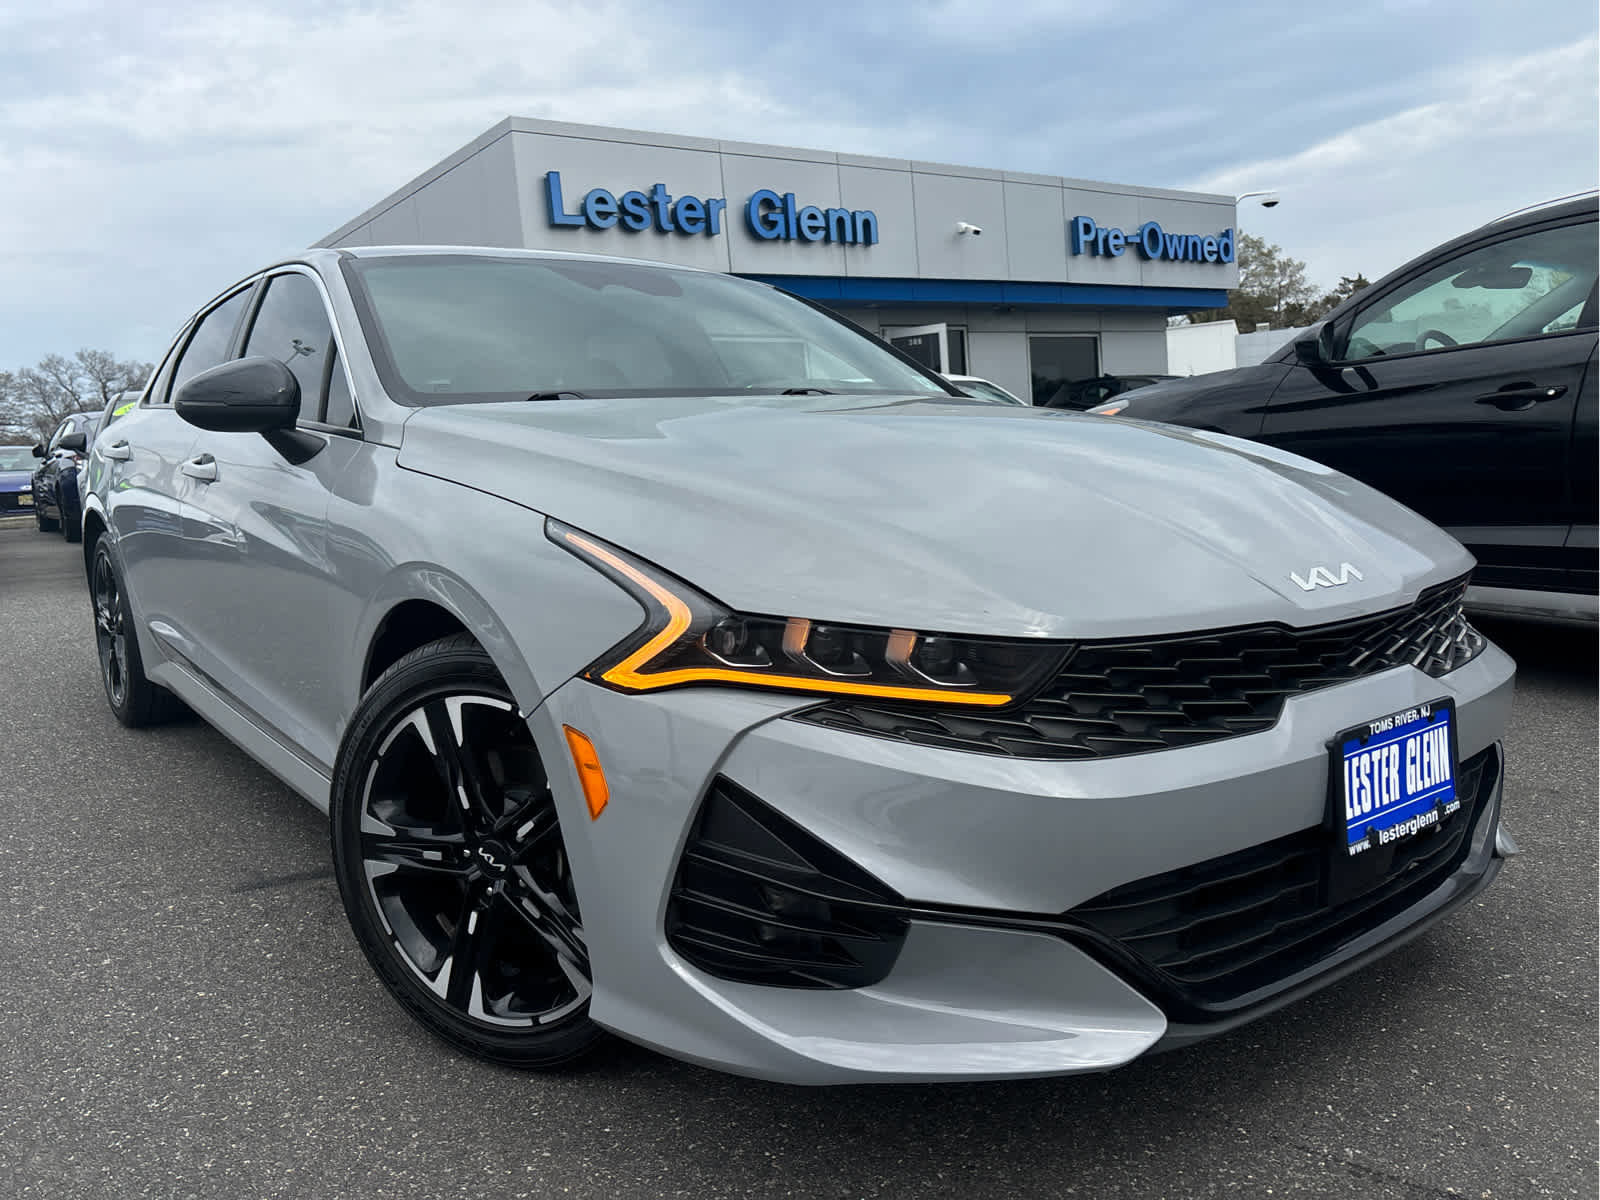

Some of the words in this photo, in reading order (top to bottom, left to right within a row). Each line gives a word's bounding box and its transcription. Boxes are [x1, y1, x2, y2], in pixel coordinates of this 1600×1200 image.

[544, 171, 726, 235] Lester
[744, 189, 879, 245] Glenn
[1071, 215, 1235, 263] Pre-Owned
[1370, 719, 1393, 735] TOMS
[1421, 705, 1431, 718] NJ
[1344, 743, 1400, 821] LESTER
[1406, 725, 1451, 795] GLENN
[1378, 809, 1439, 845] lesterglenn
[1444, 800, 1460, 815] .com
